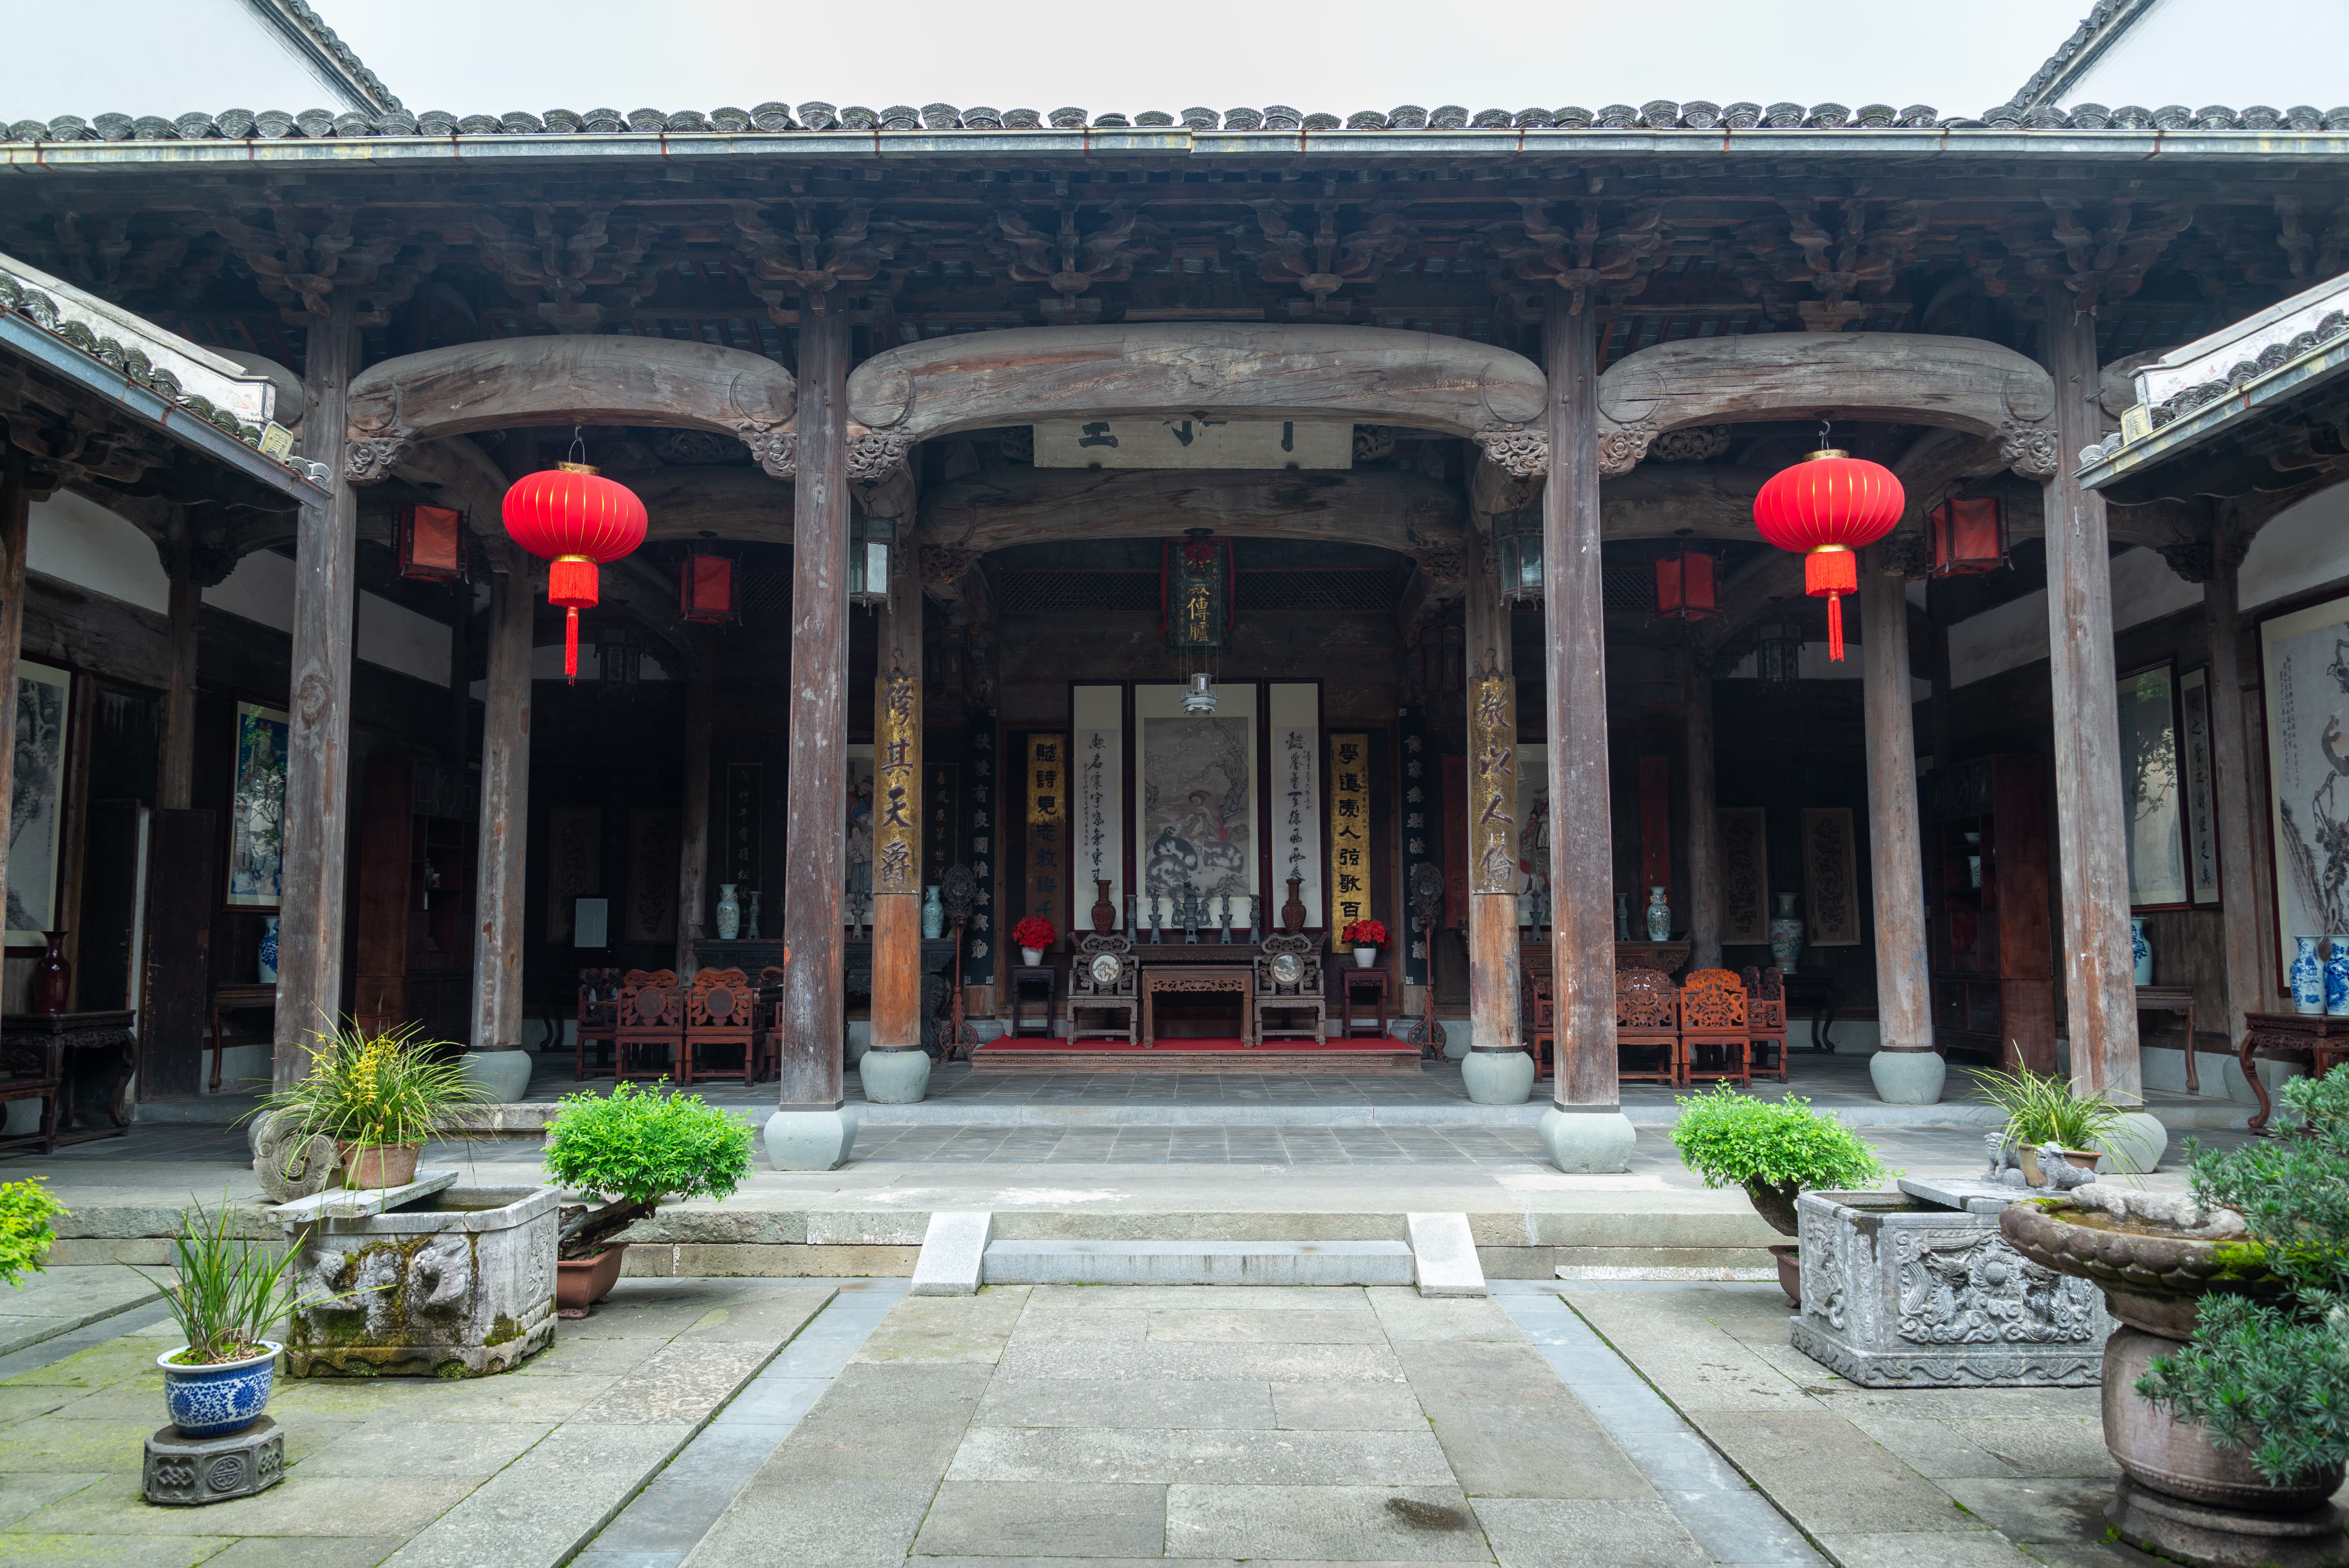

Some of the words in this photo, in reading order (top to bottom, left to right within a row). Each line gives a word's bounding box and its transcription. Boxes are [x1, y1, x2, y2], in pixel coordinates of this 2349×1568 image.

[881, 683, 913, 883] 修其天爵
[1478, 686, 1515, 885] 教以人倫
